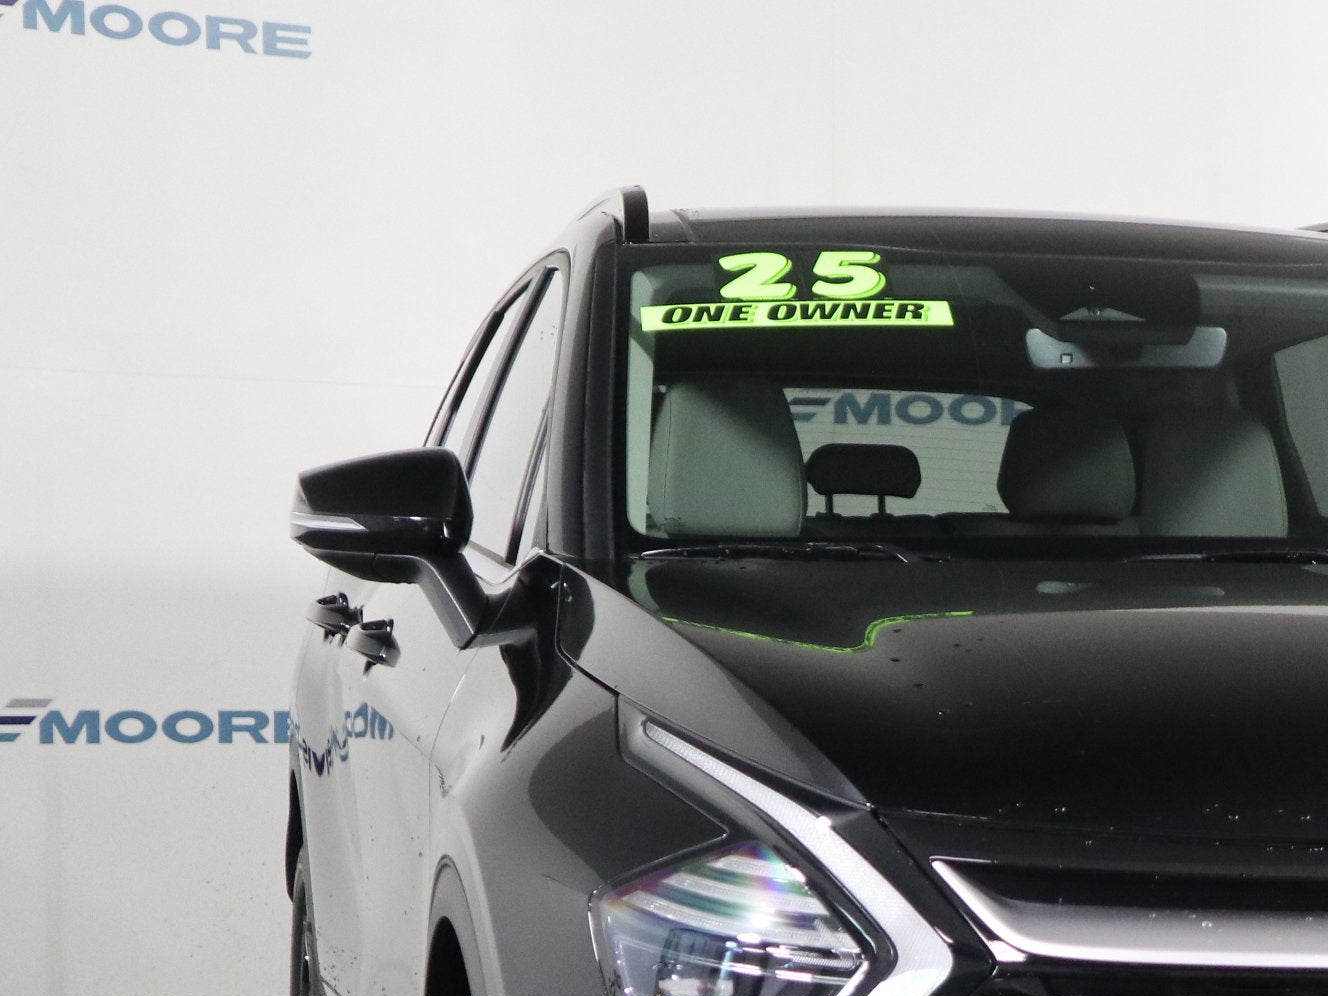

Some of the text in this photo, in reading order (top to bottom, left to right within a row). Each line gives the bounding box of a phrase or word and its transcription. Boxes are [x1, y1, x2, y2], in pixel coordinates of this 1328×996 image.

[23, 0, 312, 59] MOORE
[718, 251, 887, 299] 25
[661, 303, 929, 324] ONE OWNER
